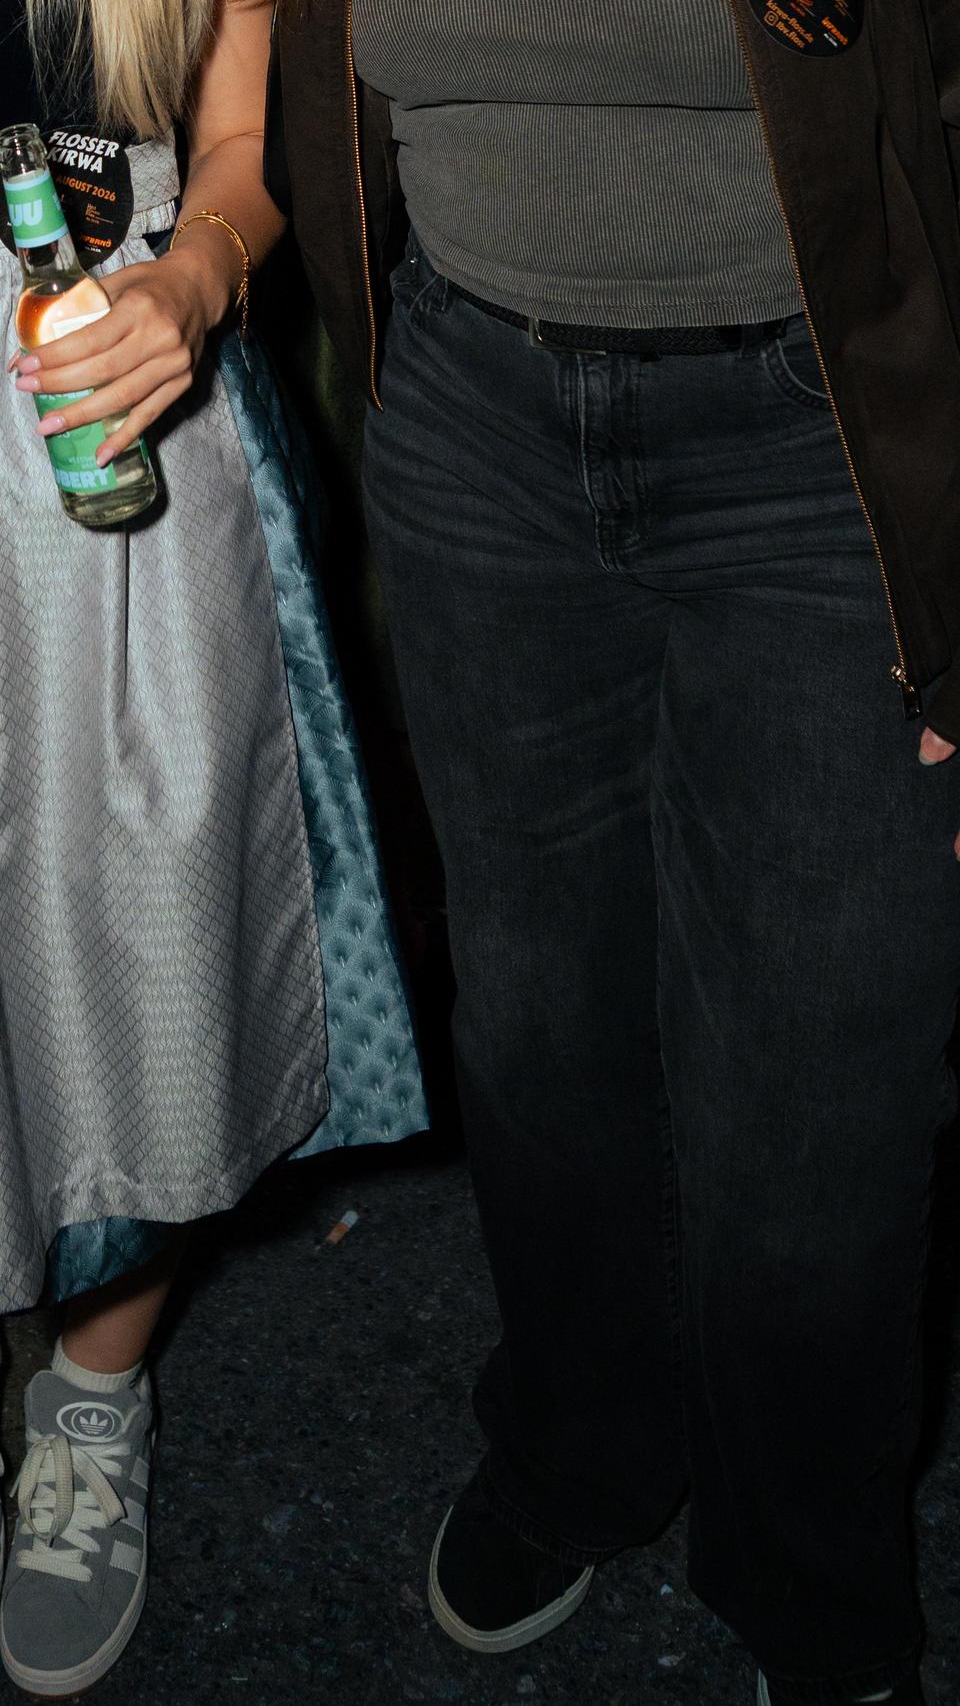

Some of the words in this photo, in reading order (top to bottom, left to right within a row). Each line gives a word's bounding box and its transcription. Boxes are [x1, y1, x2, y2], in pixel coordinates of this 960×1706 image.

[47, 130, 121, 159] FLOSSER
[45, 146, 104, 175] KIRWA
[55, 174, 93, 194] AUGUST
[91, 186, 118, 204] 2026
[55, 468, 109, 489] BERT
